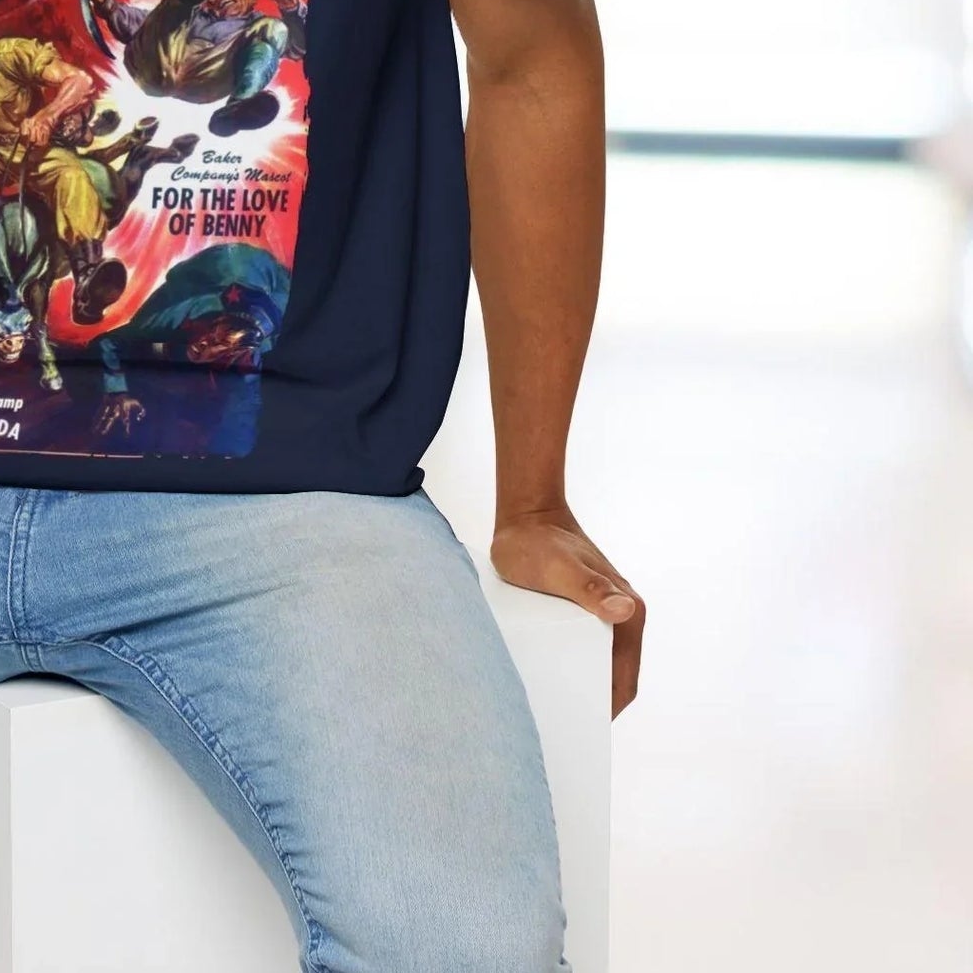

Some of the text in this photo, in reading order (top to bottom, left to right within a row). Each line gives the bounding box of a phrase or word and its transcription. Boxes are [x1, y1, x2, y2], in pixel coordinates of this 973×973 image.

[202, 150, 243, 164] Baker
[170, 166, 292, 183] Company's Mascot
[152, 187, 289, 213] FOR THE LOVE
[169, 213, 266, 237] OF BENNY
